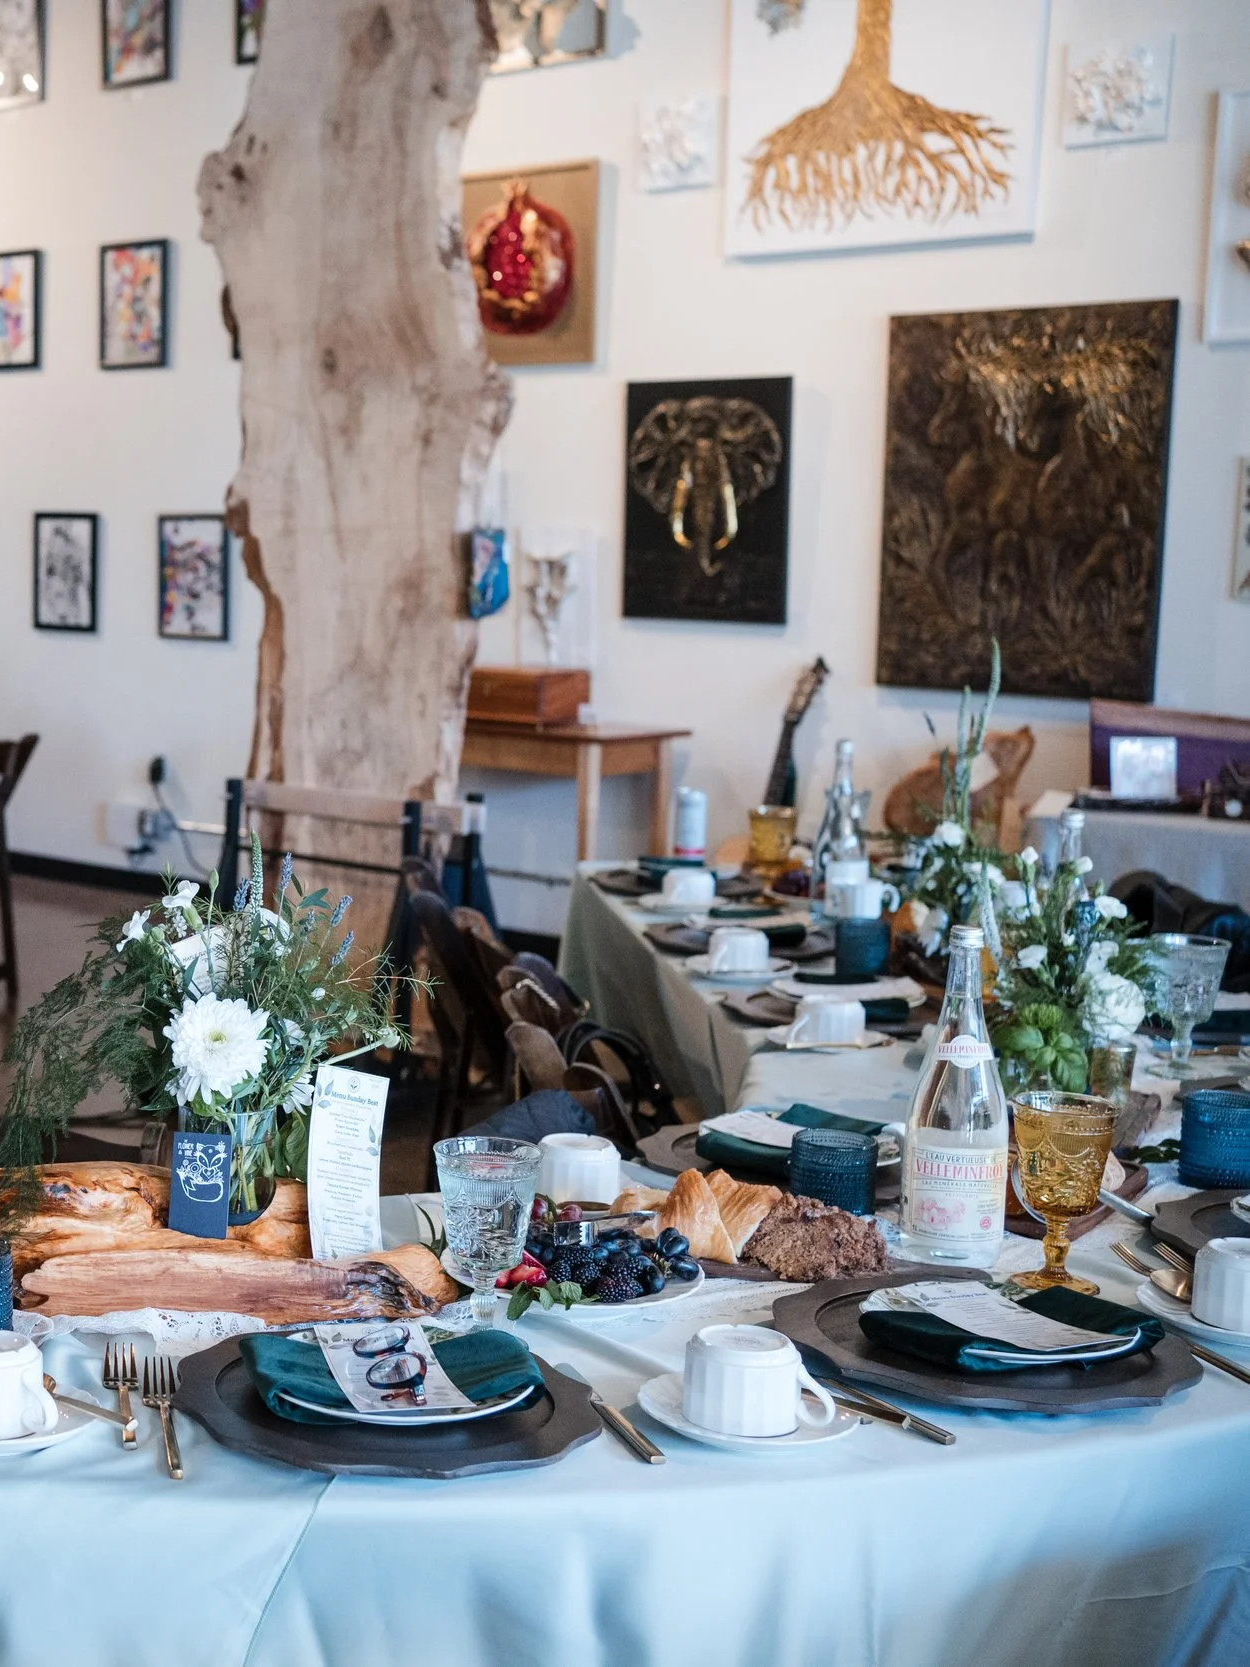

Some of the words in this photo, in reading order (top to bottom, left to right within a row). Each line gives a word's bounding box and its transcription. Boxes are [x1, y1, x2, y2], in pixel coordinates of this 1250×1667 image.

[331, 1091, 347, 1099] Menu
[347, 1095, 366, 1104] Sunday
[916, 1158, 1004, 1180] VELLEMINFROY
